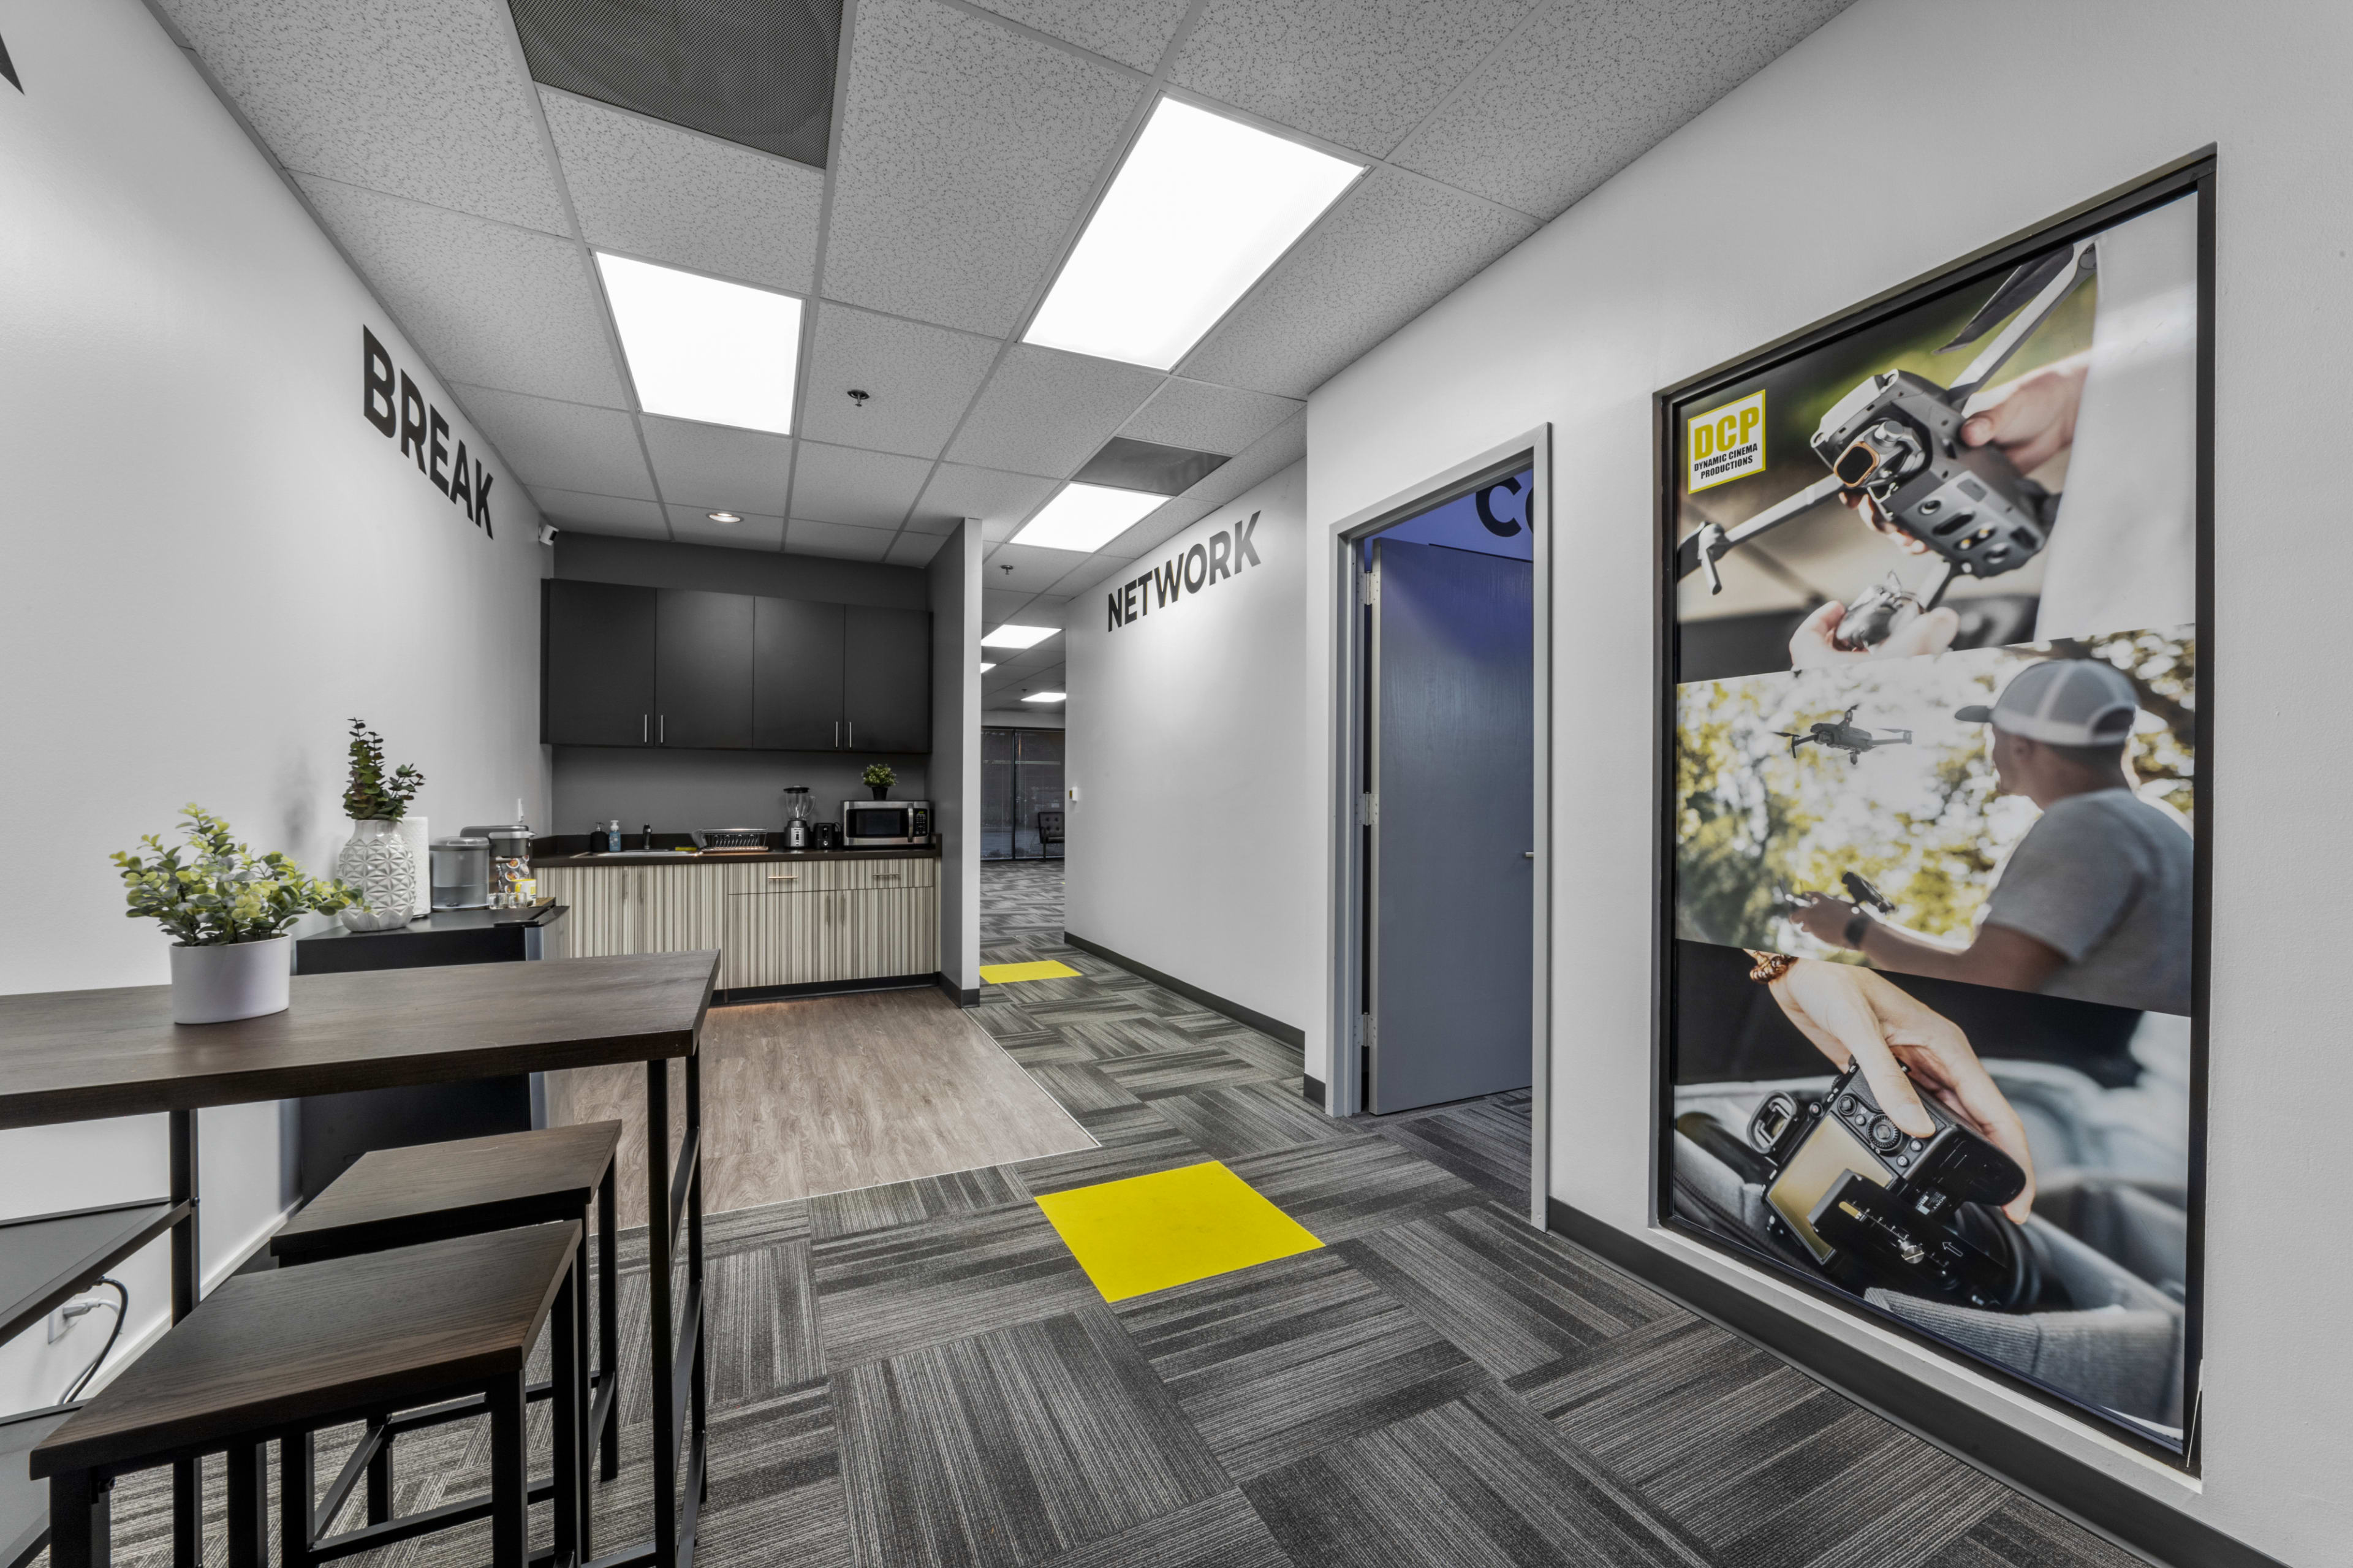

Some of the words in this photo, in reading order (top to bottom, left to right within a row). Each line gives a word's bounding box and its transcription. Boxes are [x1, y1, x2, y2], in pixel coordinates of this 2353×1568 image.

[363, 324, 493, 540] BREAK
[1694, 406, 1760, 461] DCP
[1694, 453, 1727, 471] DYNAMIC
[1729, 443, 1758, 460] CINEMA
[1701, 455, 1753, 479] PRODUCTIONS
[1476, 477, 1534, 537] C
[1108, 510, 1261, 632] NETWORK
[1933, 1195, 1947, 1210] SONY
